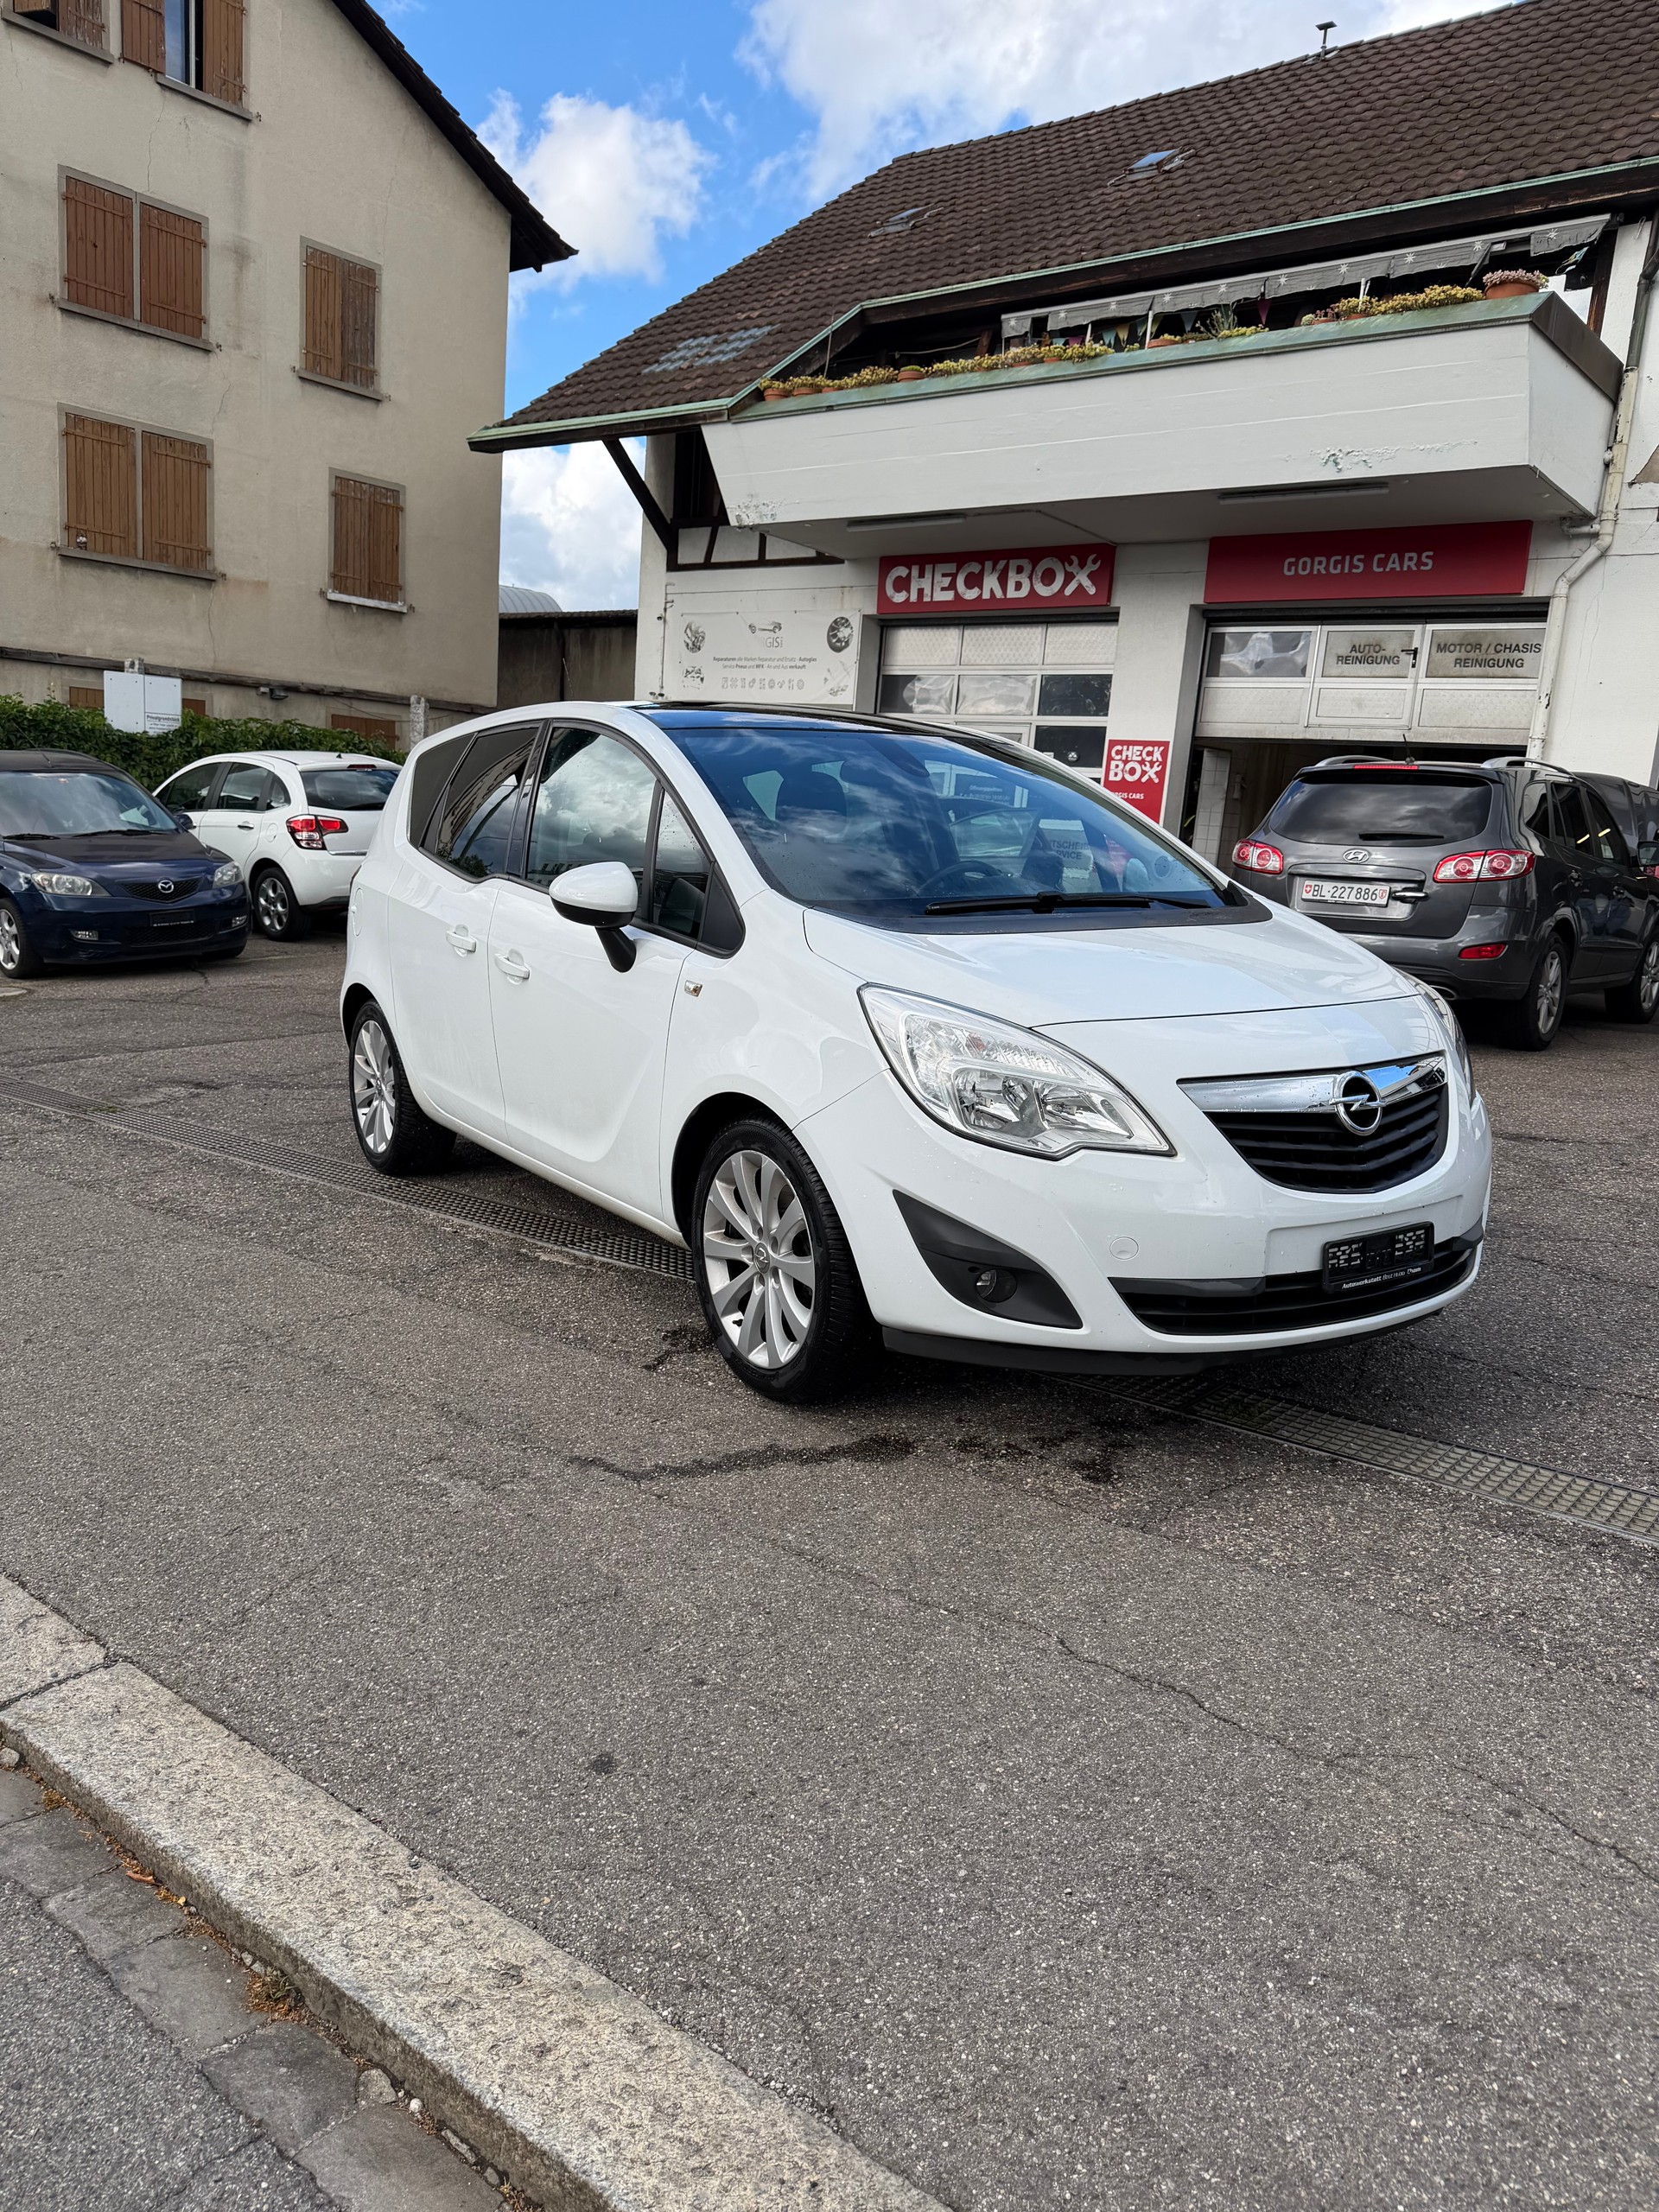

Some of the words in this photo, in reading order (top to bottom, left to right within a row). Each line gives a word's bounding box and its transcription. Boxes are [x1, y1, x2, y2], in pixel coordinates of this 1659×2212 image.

[1283, 555, 1365, 575] GORGIS
[1372, 551, 1434, 573] CARS
[885, 554, 1102, 603] CHECKBOX
[1350, 644, 1387, 654] AUTO-
[1436, 643, 1483, 654] MOTOR
[1493, 643, 1541, 654] CHASIS
[1336, 655, 1401, 665] REINIGUNG
[1453, 658, 1525, 668] REINIGUNG
[1111, 745, 1165, 761] CHECK
[1109, 760, 1162, 783] BOX
